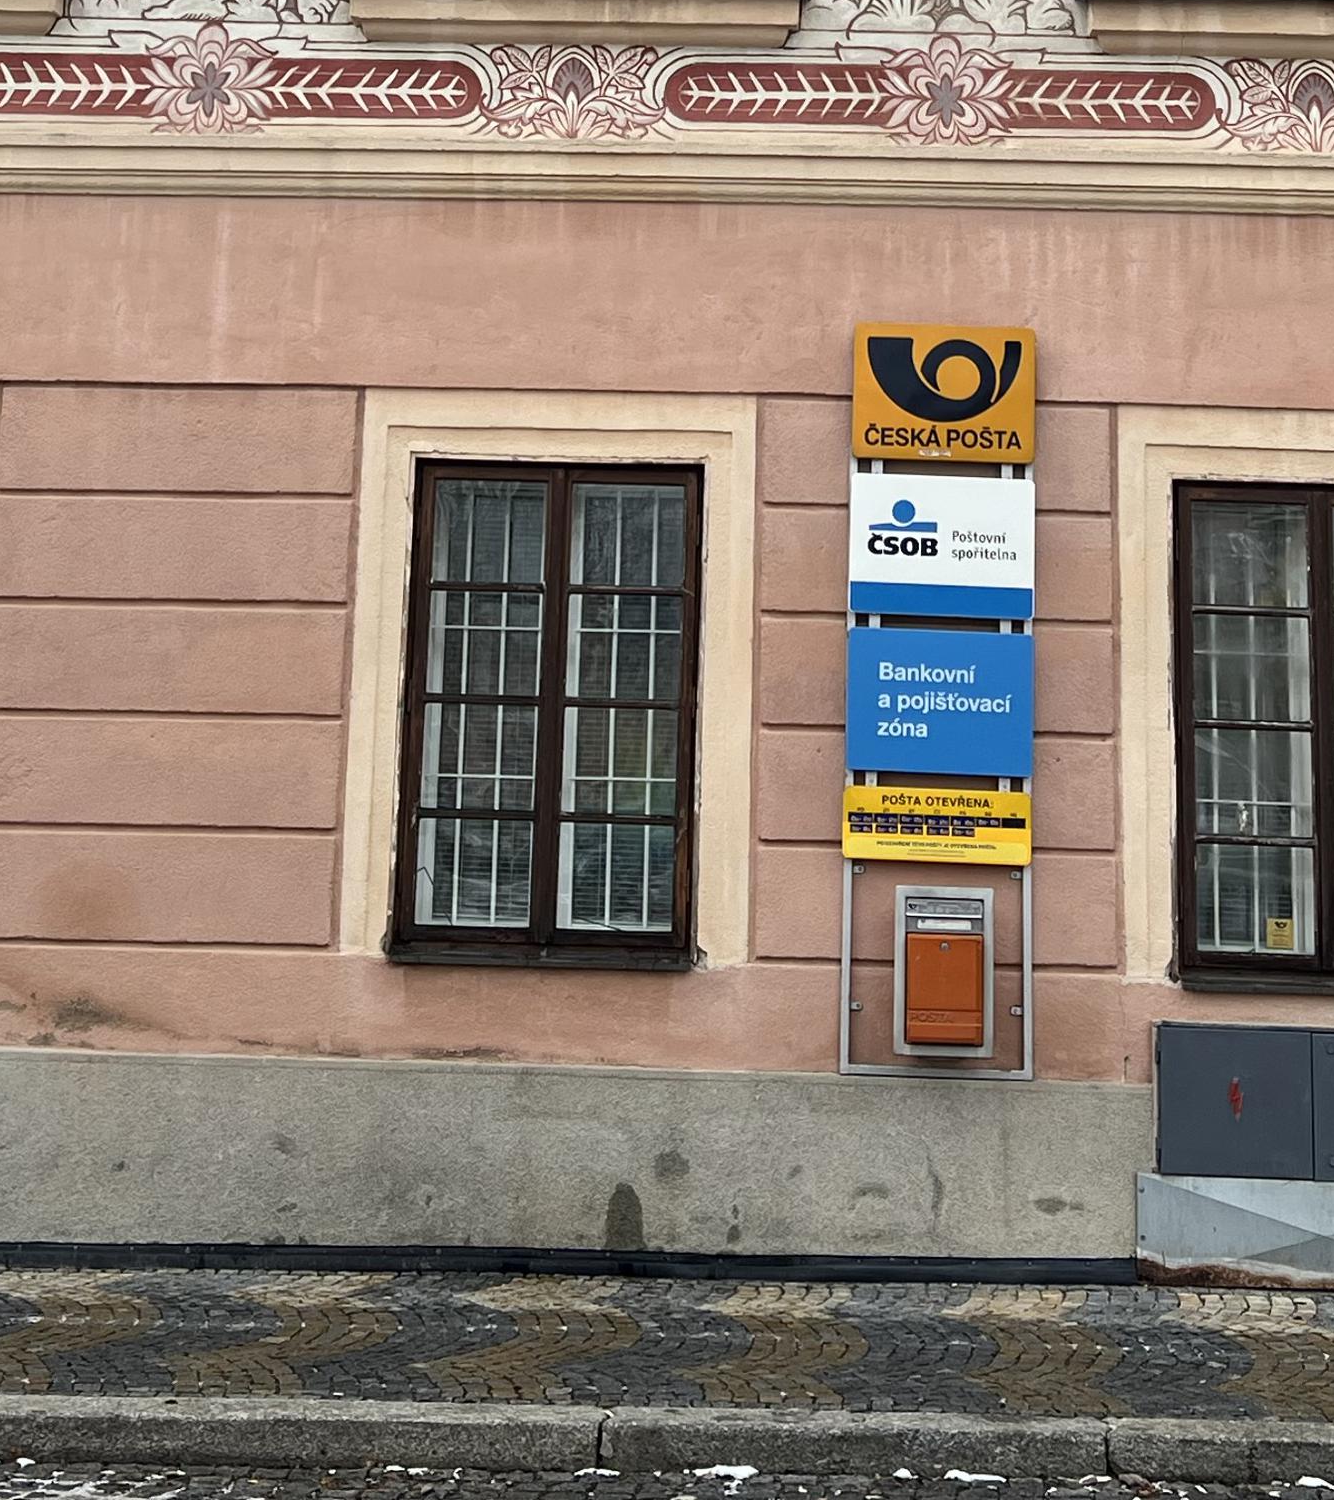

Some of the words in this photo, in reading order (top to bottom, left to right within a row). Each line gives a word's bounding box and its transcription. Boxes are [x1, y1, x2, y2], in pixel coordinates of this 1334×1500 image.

[864, 423, 941, 448] ČESKÁ
[946, 426, 1022, 449] POŠTA
[867, 533, 938, 556] ČSOB
[952, 531, 1007, 545] Poštovní
[951, 547, 1017, 561] spořitelna
[878, 661, 976, 684] Bankovní
[878, 695, 890, 709] a
[897, 692, 1012, 715] pojišťovací
[877, 718, 928, 738] zóna
[881, 793, 921, 806] POŠTA
